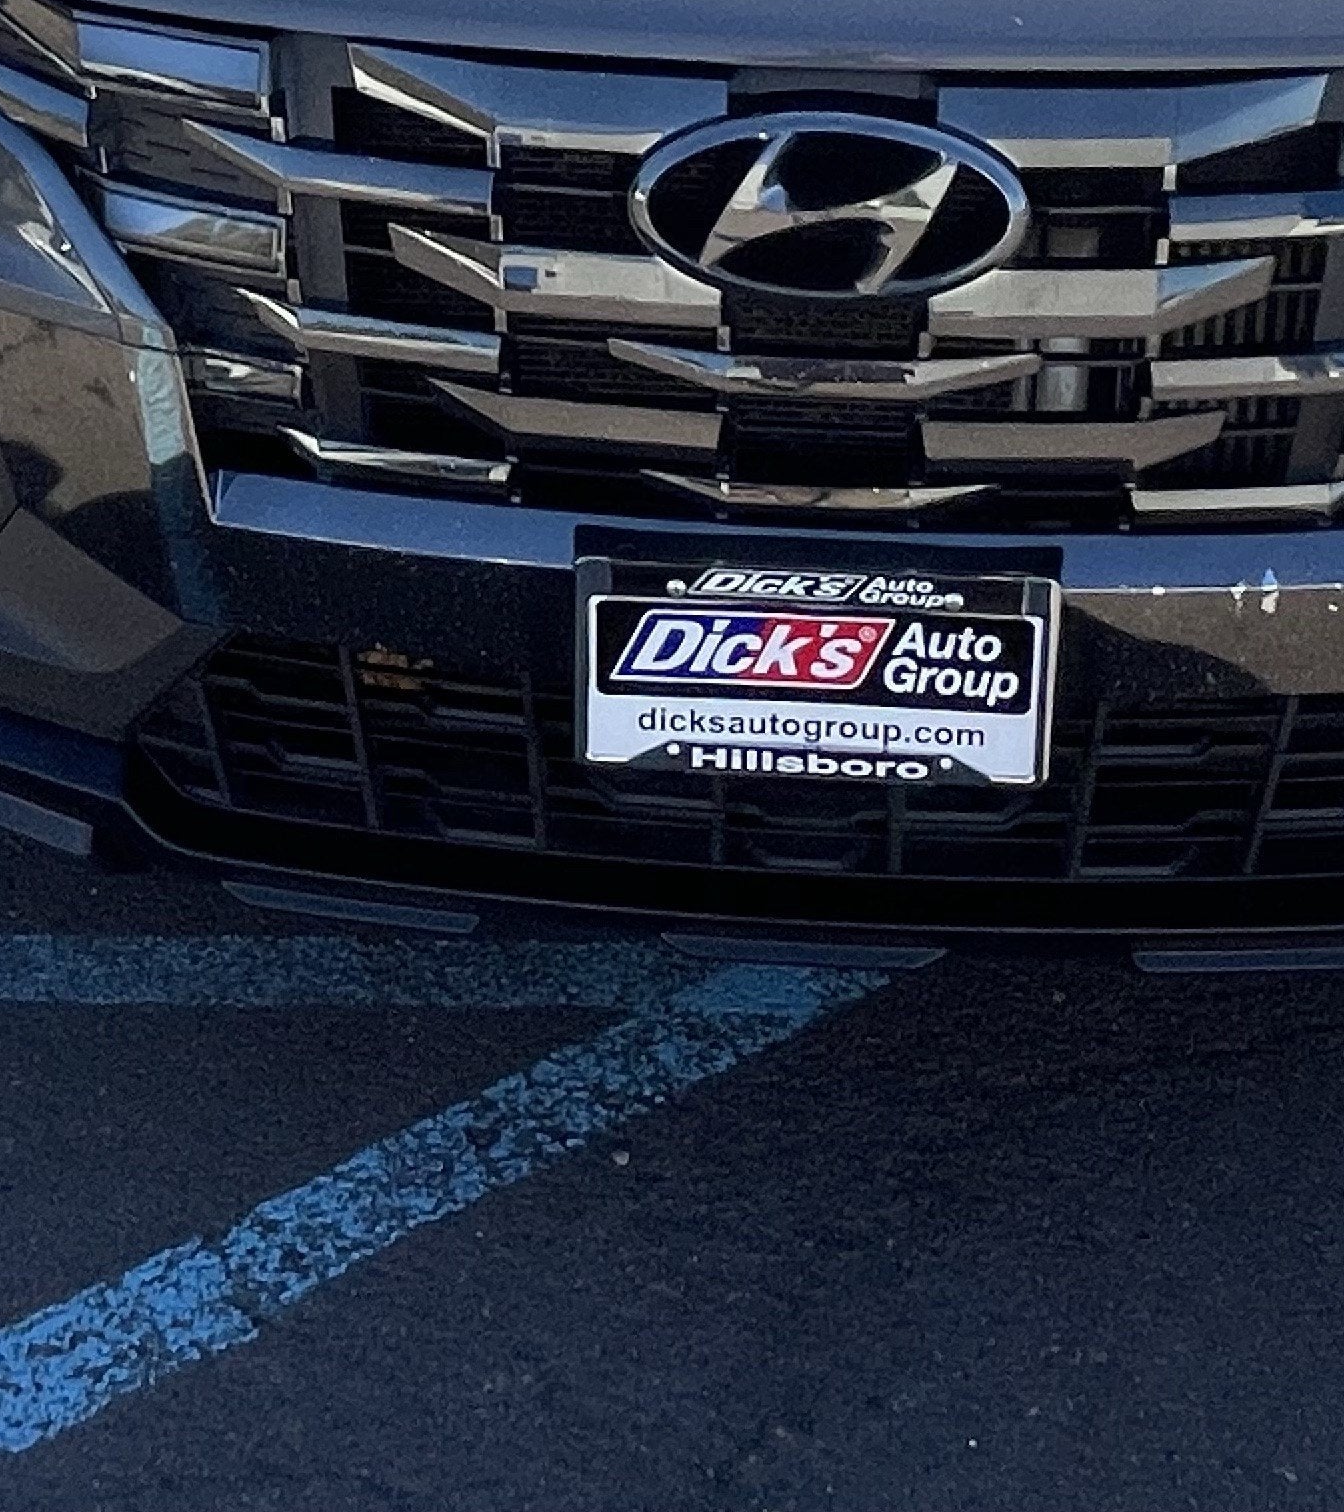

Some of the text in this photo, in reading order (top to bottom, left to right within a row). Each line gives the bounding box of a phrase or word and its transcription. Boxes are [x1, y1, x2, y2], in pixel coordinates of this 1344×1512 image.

[858, 588, 945, 609] Group
[866, 575, 934, 594] Auto
[630, 619, 863, 679] Dick's
[892, 622, 1003, 662] Auto
[883, 659, 1019, 705] Group
[637, 707, 985, 747] dicksautogroup.com
[690, 745, 929, 779] Hillsboro
